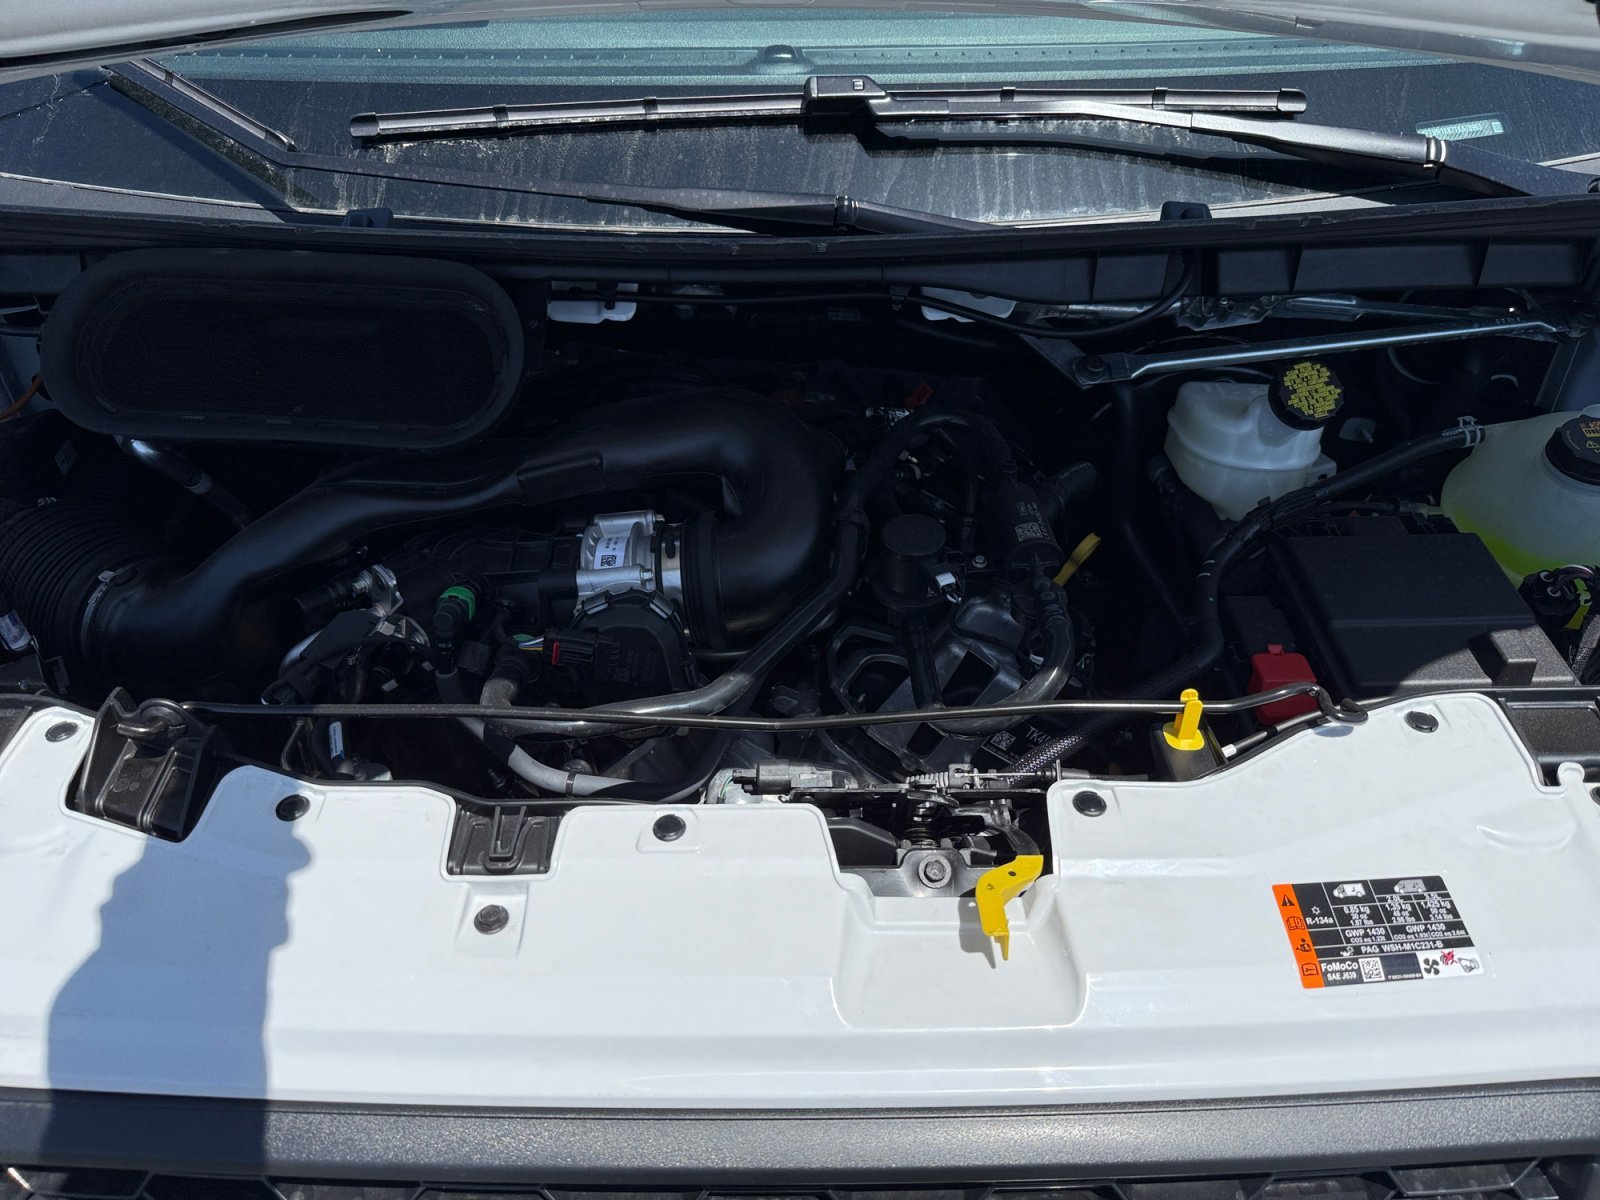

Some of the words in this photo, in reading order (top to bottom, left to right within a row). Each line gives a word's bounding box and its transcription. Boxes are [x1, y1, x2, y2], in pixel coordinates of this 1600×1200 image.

[1360, 905, 1370, 914] kg
[1401, 902, 1412, 912] kg
[1440, 900, 1451, 909] kg
[1306, 916, 1334, 925] R-134a
[1345, 928, 1364, 938] GWP
[1366, 927, 1386, 936] 1430
[1406, 924, 1426, 933] GWP
[1427, 923, 1446, 932] 1430
[1360, 944, 1380, 954] PAG
[1320, 961, 1358, 972] FoMoCo
[1342, 972, 1356, 980] J639
